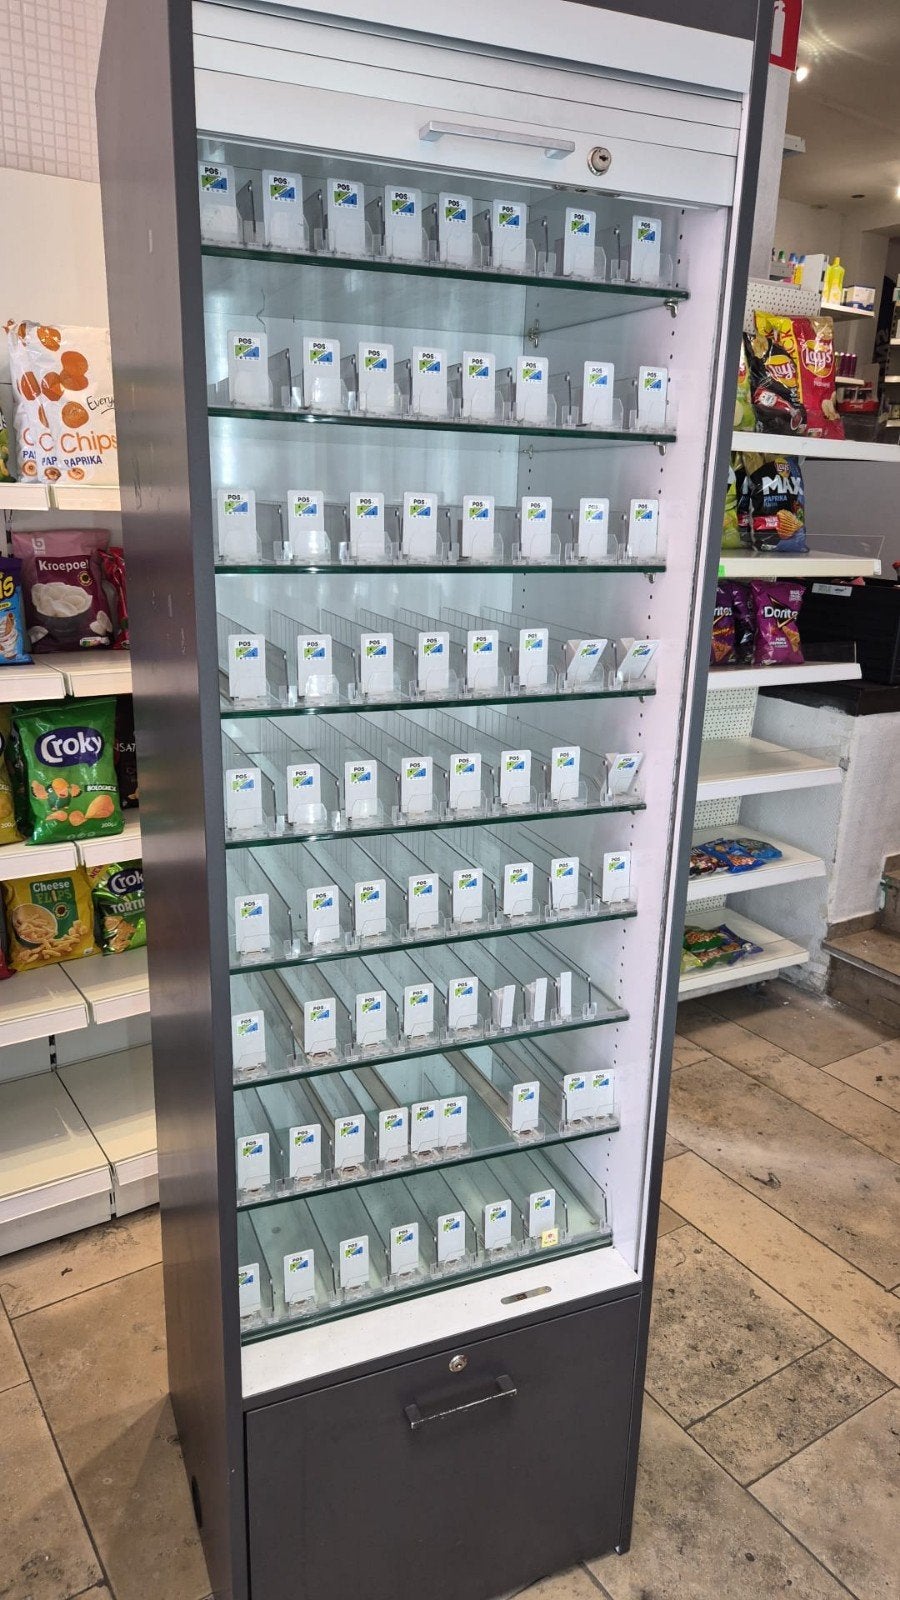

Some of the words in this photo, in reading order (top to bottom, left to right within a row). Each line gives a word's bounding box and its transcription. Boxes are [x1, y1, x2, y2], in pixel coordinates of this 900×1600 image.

[205, 167, 218, 175] POS
[63, 455, 103, 468] PAPRIKA
[762, 474, 804, 496] MAX
[40, 731, 103, 763] Croky
[32, 880, 70, 893] Cheese
